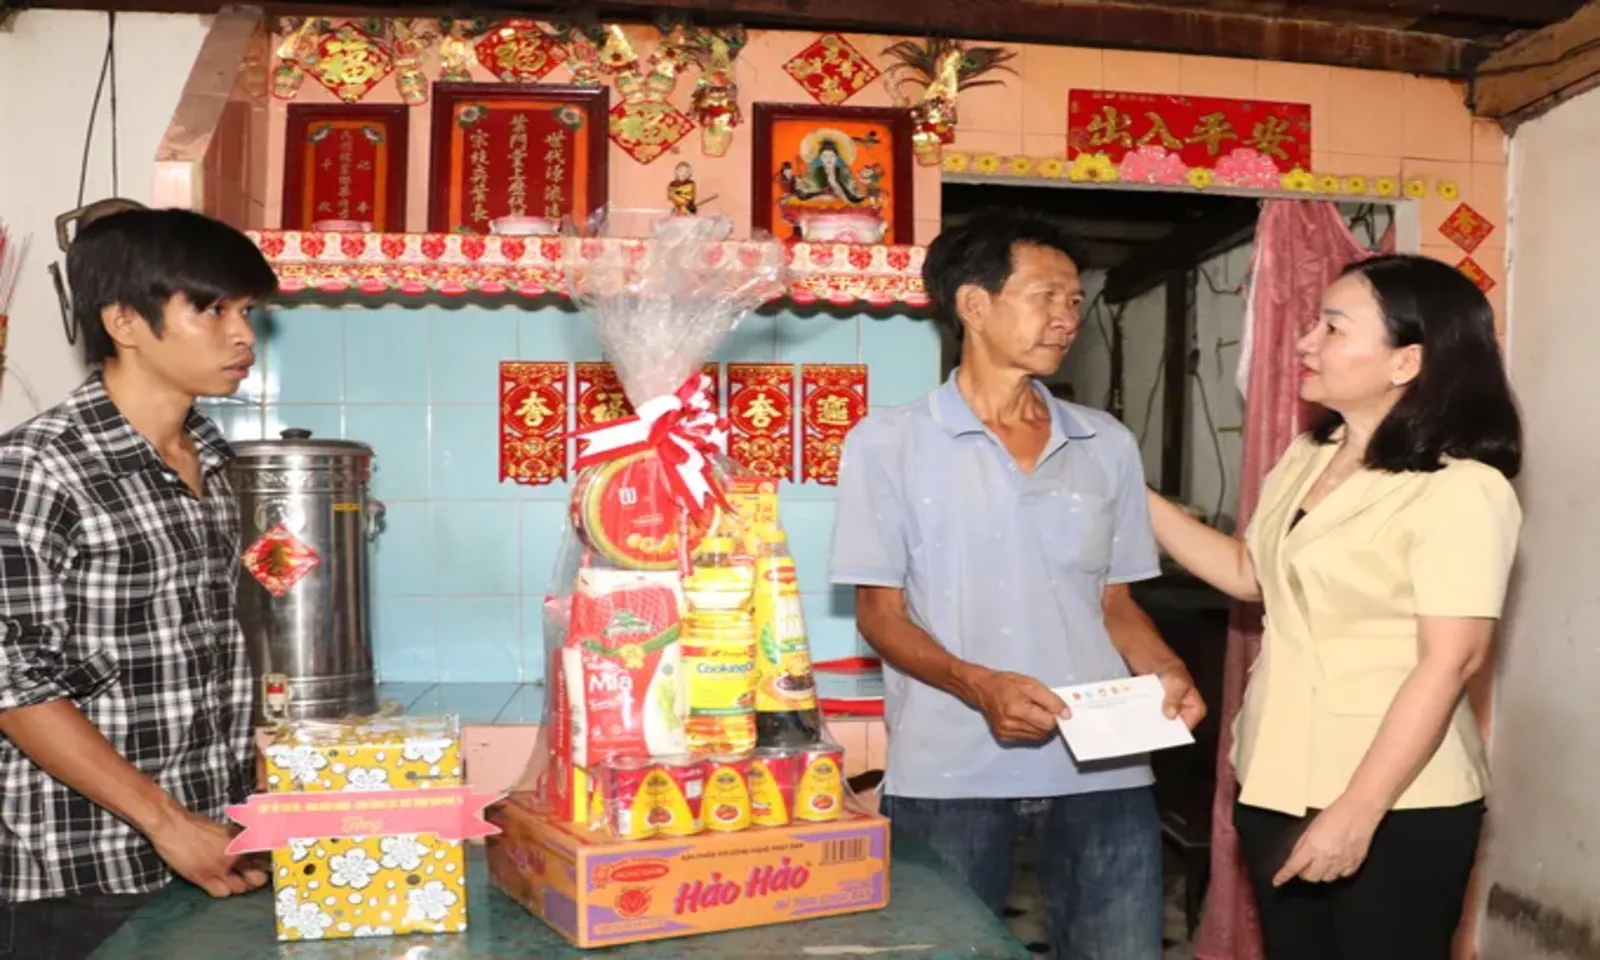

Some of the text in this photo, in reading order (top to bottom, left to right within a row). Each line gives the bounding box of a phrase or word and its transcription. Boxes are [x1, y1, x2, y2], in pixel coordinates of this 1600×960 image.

[1085, 104, 1296, 161] 出入平安
[673, 871, 741, 915] Hảo
[745, 856, 811, 899] Hảo
